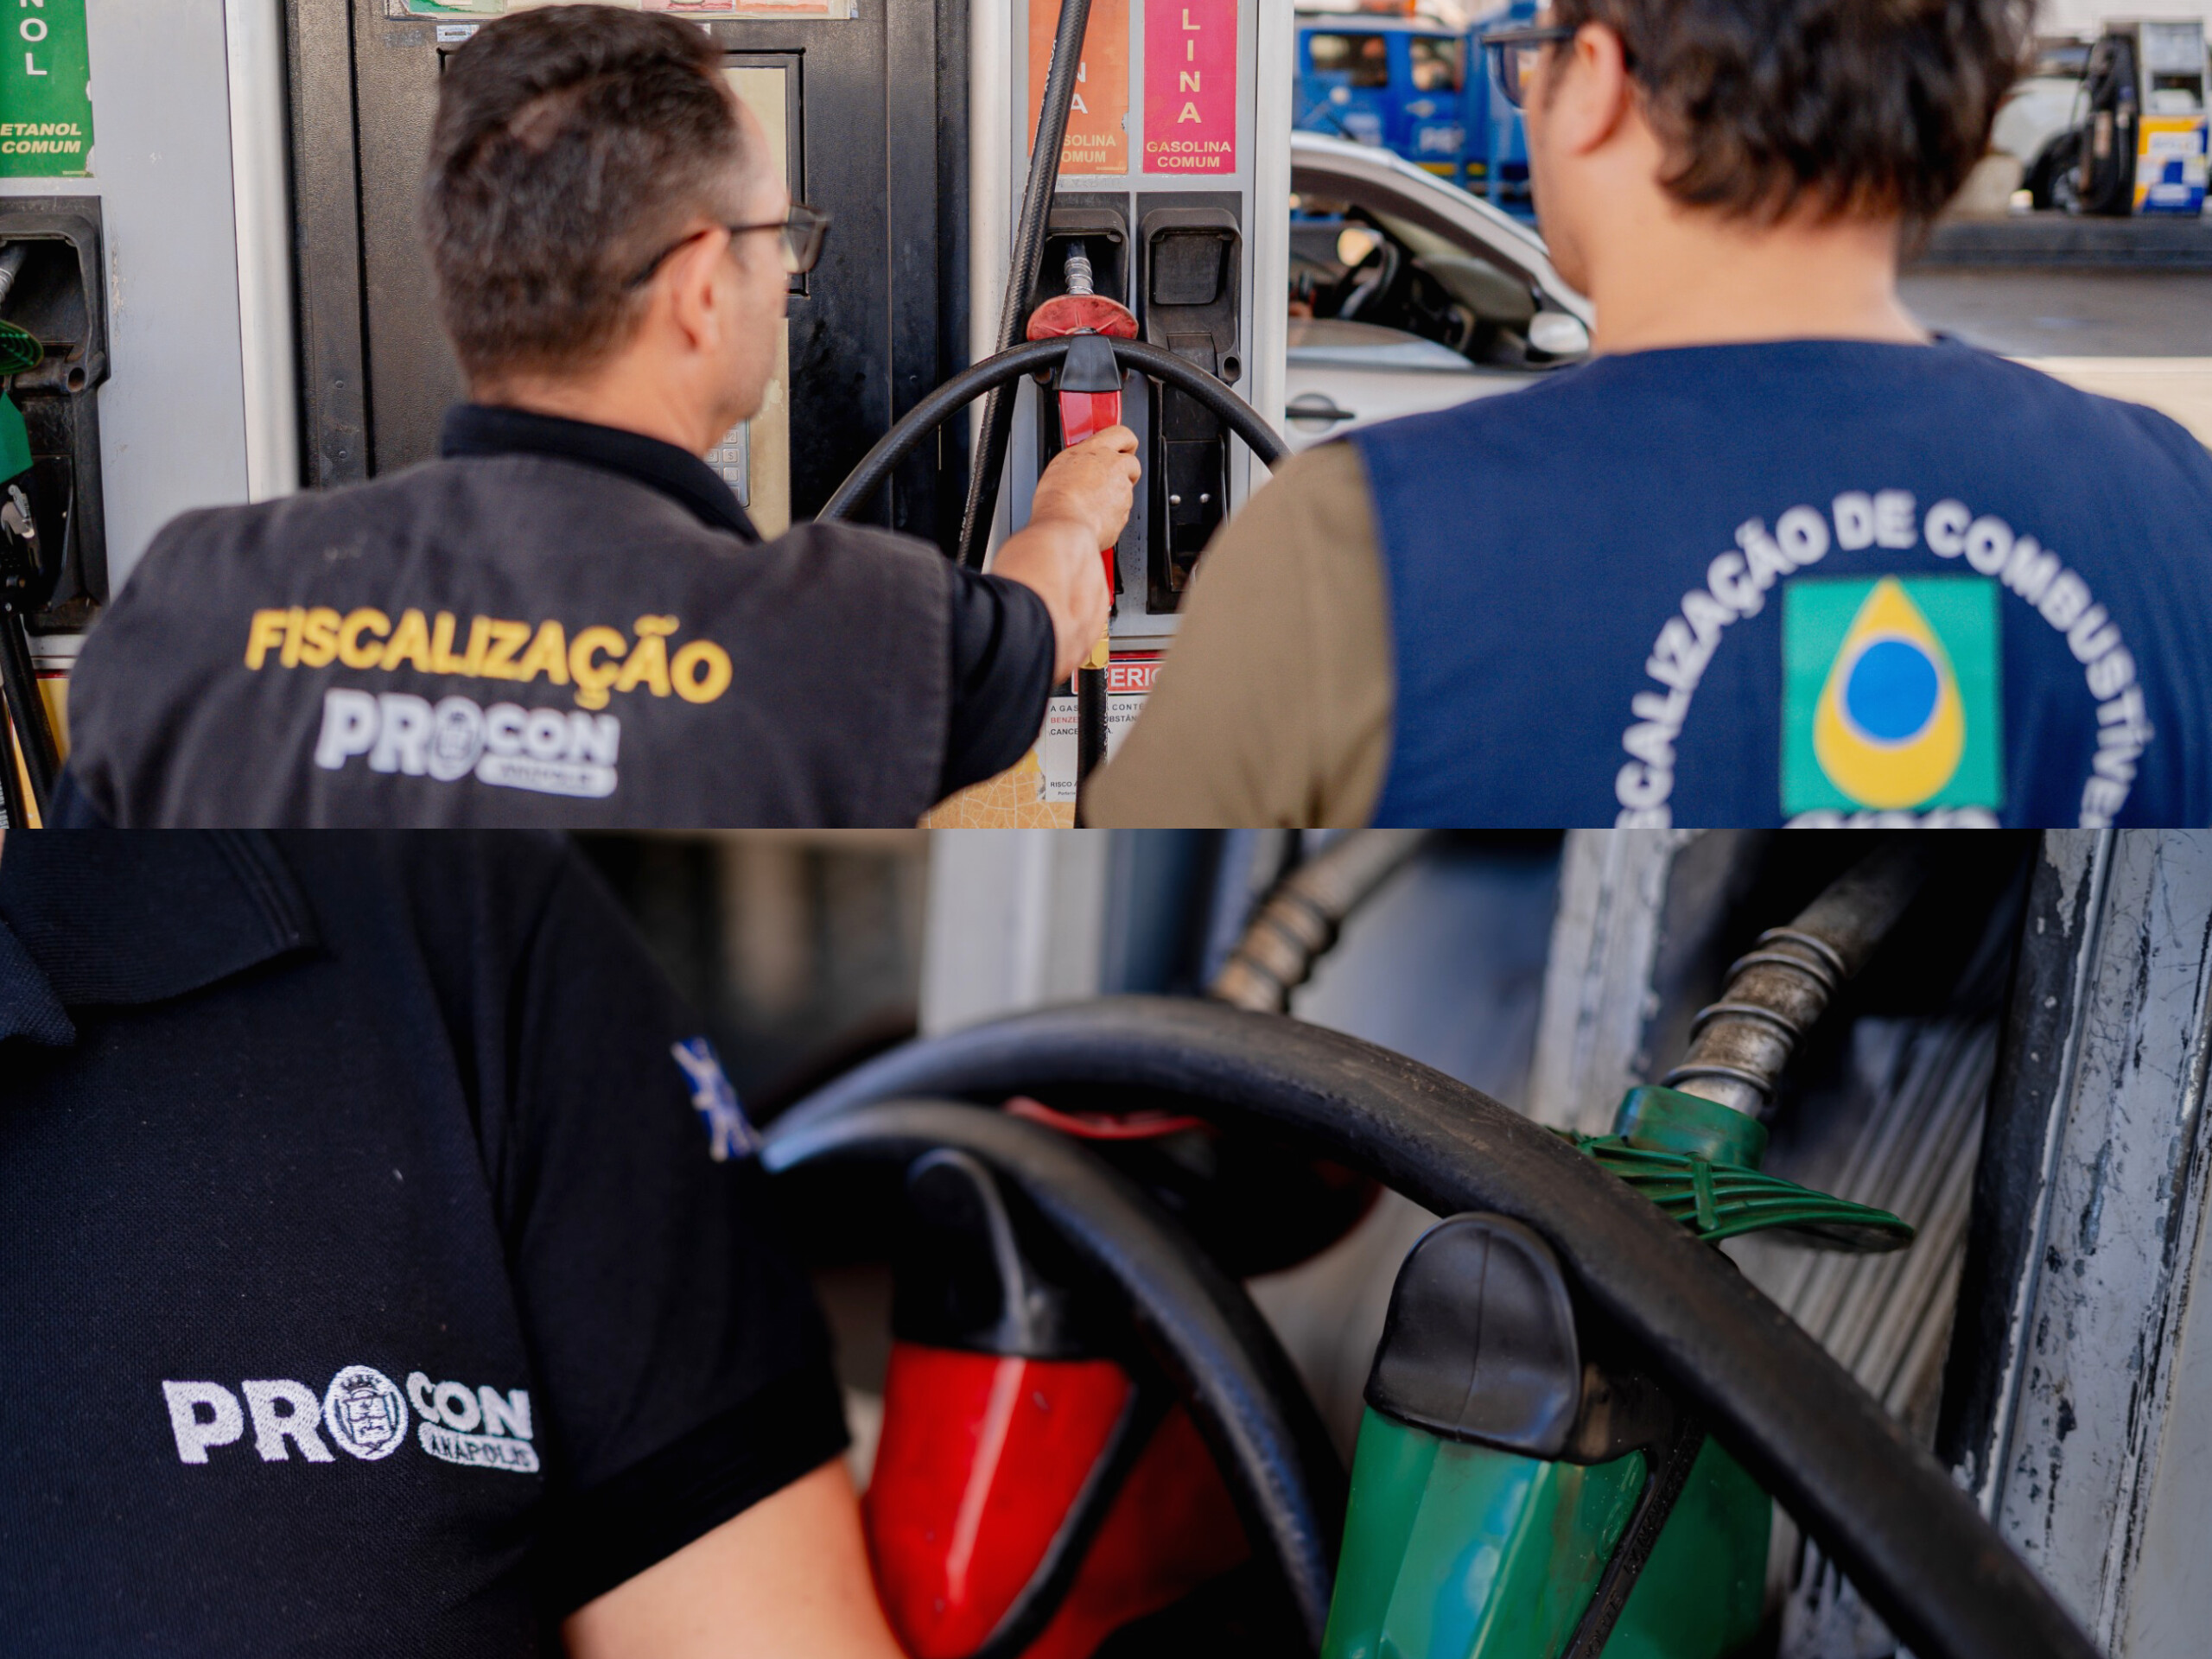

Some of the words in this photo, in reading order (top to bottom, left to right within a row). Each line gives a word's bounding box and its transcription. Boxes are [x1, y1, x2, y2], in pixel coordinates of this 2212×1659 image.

[0, 123, 82, 137] ETANOL
[1063, 134, 1116, 147] SOLINA
[1146, 141, 1231, 153] GASOLINA
[2, 141, 81, 154] COMUM
[1061, 150, 1106, 162] OMUM
[1157, 156, 1220, 168] COMUM
[1832, 488, 1917, 550] DE
[245, 606, 733, 709] FISCALIZAÇÃO
